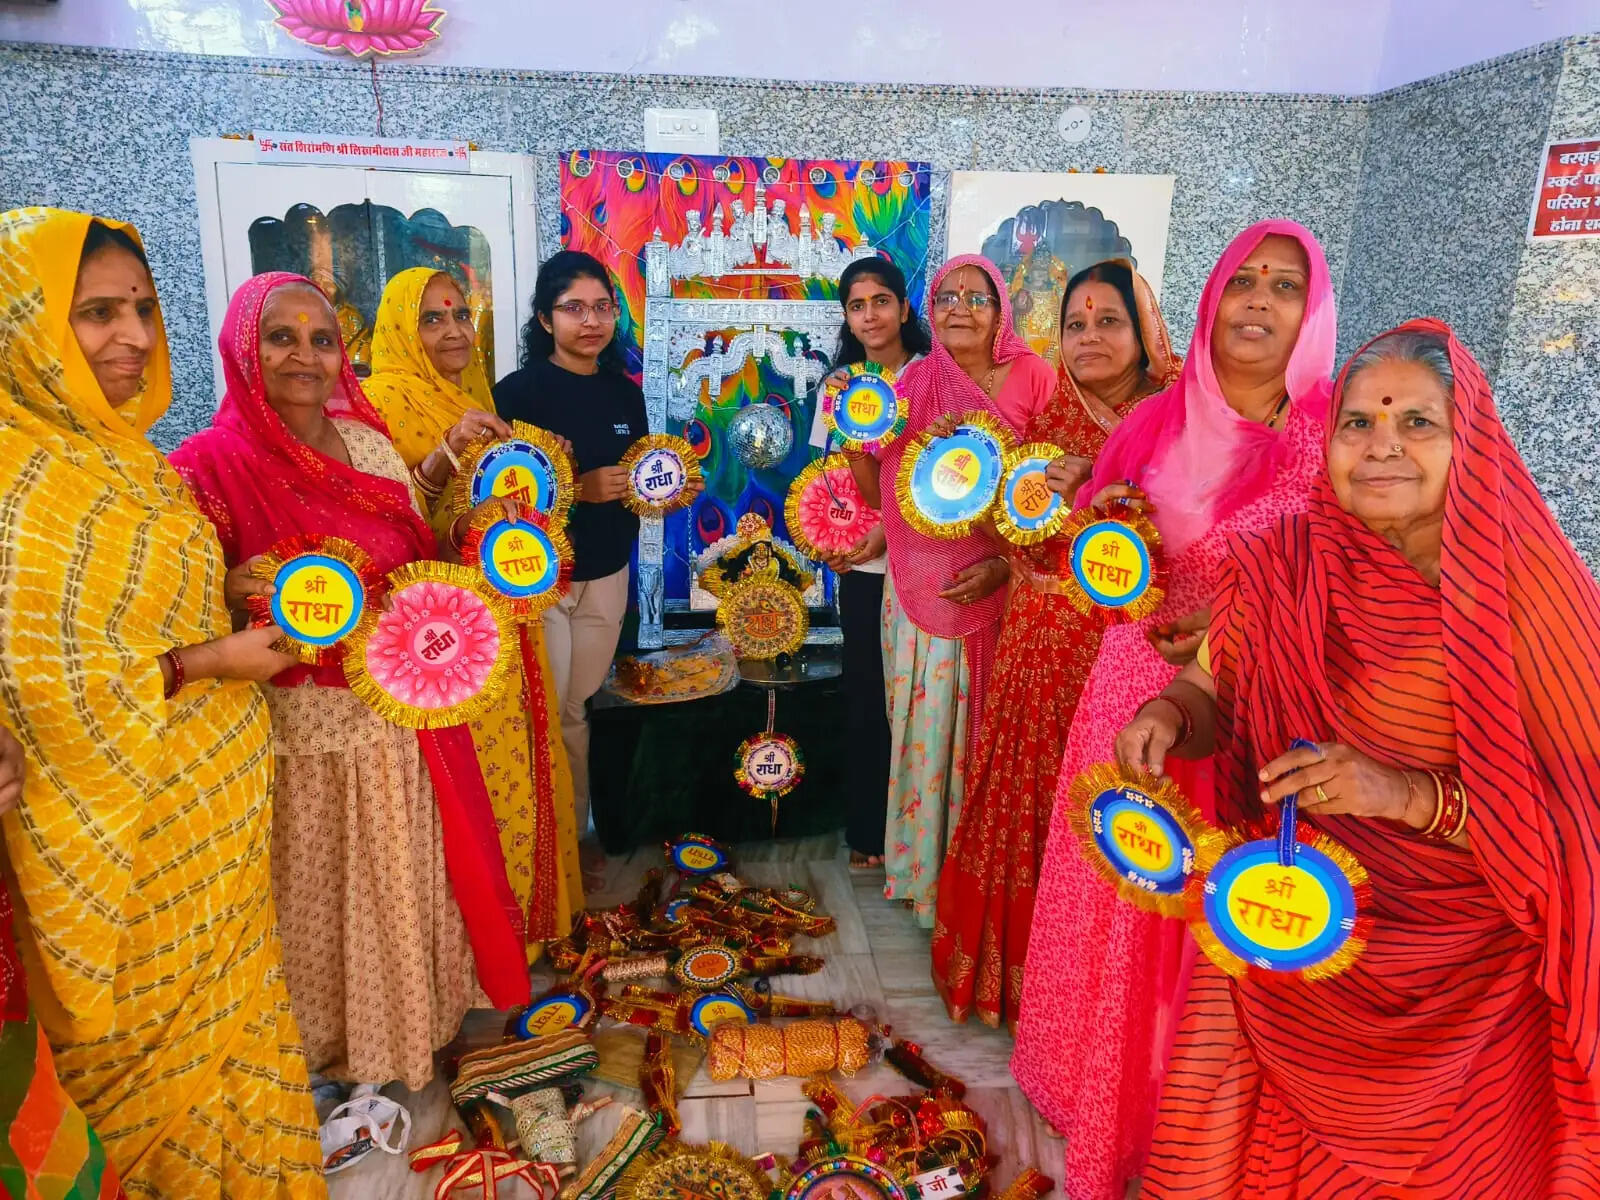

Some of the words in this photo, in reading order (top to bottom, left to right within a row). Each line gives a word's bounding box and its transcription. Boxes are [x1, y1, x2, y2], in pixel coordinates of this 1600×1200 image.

[279, 141, 293, 152] संत
[337, 143, 347, 155] श्री
[401, 146, 412, 157] जी
[1547, 193, 1591, 209] परिसर
[850, 403, 877, 418] राधा
[650, 461, 665, 476] श्री
[504, 468, 519, 489] श्री
[645, 472, 673, 491] राधा
[830, 507, 853, 521] राधा
[507, 537, 524, 553] श्री
[1101, 541, 1119, 560] श्री
[499, 555, 542, 579] राधा
[1087, 560, 1132, 589] राधा
[304, 576, 327, 594] श्री
[287, 600, 344, 625] राधा
[421, 630, 457, 662] राधा
[424, 630, 437, 646] श्री
[763, 752, 776, 765] श्री
[756, 763, 783, 777] राधा
[1115, 827, 1162, 861] राधा
[1264, 876, 1296, 900] श्री
[1236, 897, 1312, 939] राधा
[926, 1174, 947, 1192] जी
